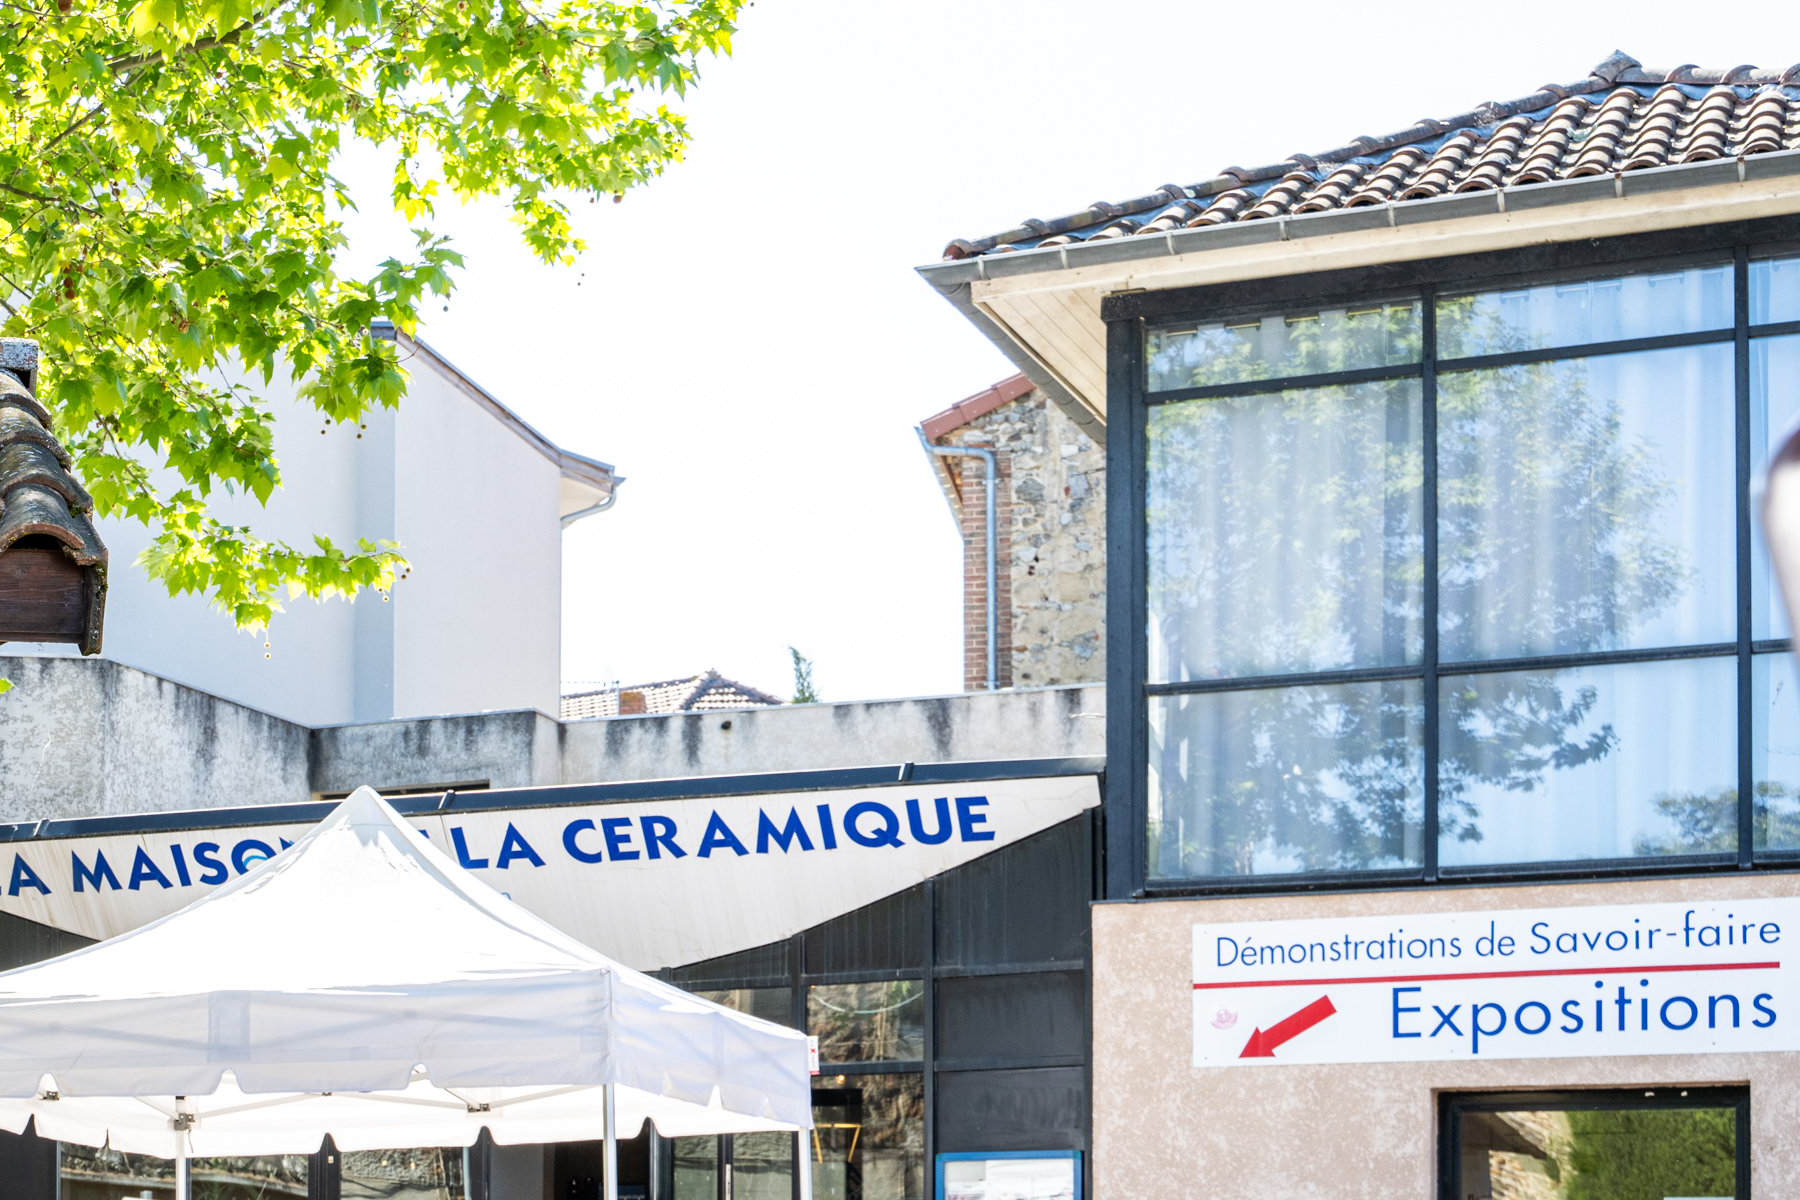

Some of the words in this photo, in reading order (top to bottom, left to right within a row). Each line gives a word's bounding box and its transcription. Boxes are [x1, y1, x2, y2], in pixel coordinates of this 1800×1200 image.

[71, 839, 294, 893] MAISO
[452, 822, 545, 869] LA
[562, 795, 996, 864] CERAMIQUE
[1216, 929, 1461, 967] Démonstrations
[1476, 921, 1516, 957] de
[1530, 910, 1781, 953] Savoir-faire
[1392, 979, 1778, 1055] Expositions
